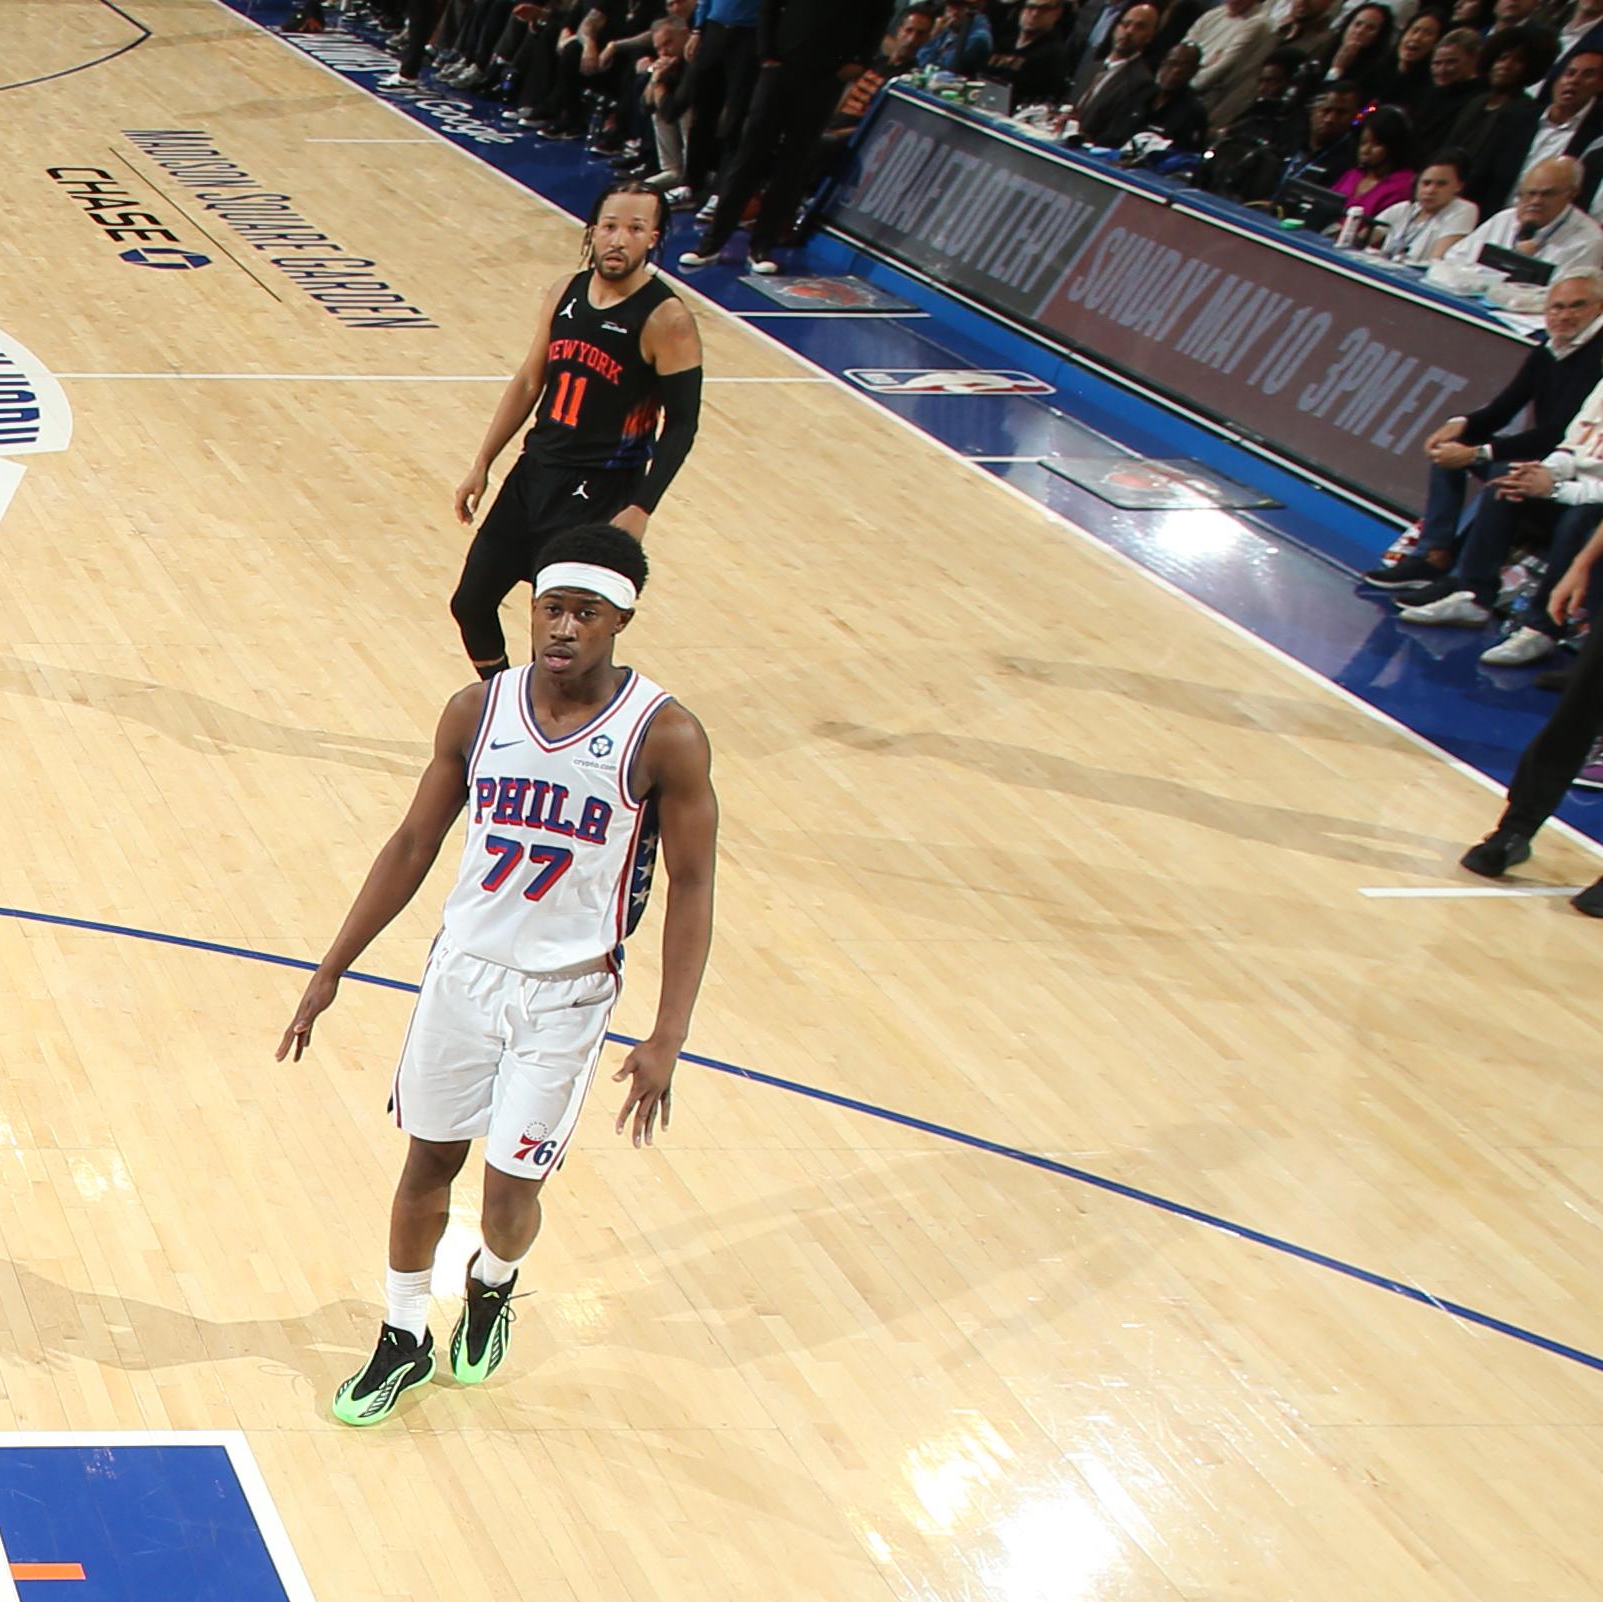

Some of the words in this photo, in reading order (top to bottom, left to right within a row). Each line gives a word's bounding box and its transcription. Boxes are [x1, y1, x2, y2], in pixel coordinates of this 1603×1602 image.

[416, 100, 523, 144] Google
[45, 167, 181, 243] CHASE
[121, 130, 263, 188] MADISON
[194, 193, 343, 251] SQUARE
[270, 257, 441, 329] GARDEN
[929, 162, 1094, 293] LOTTERY
[1067, 227, 1221, 343] SUNDAY
[1175, 273, 1293, 375] MAY
[1245, 306, 1333, 395] 10
[577, 341, 623, 385] YORK
[550, 371, 587, 428] 11
[474, 776, 613, 845] PHILA
[481, 834, 574, 902] 77
[513, 1133, 557, 1166] 76
